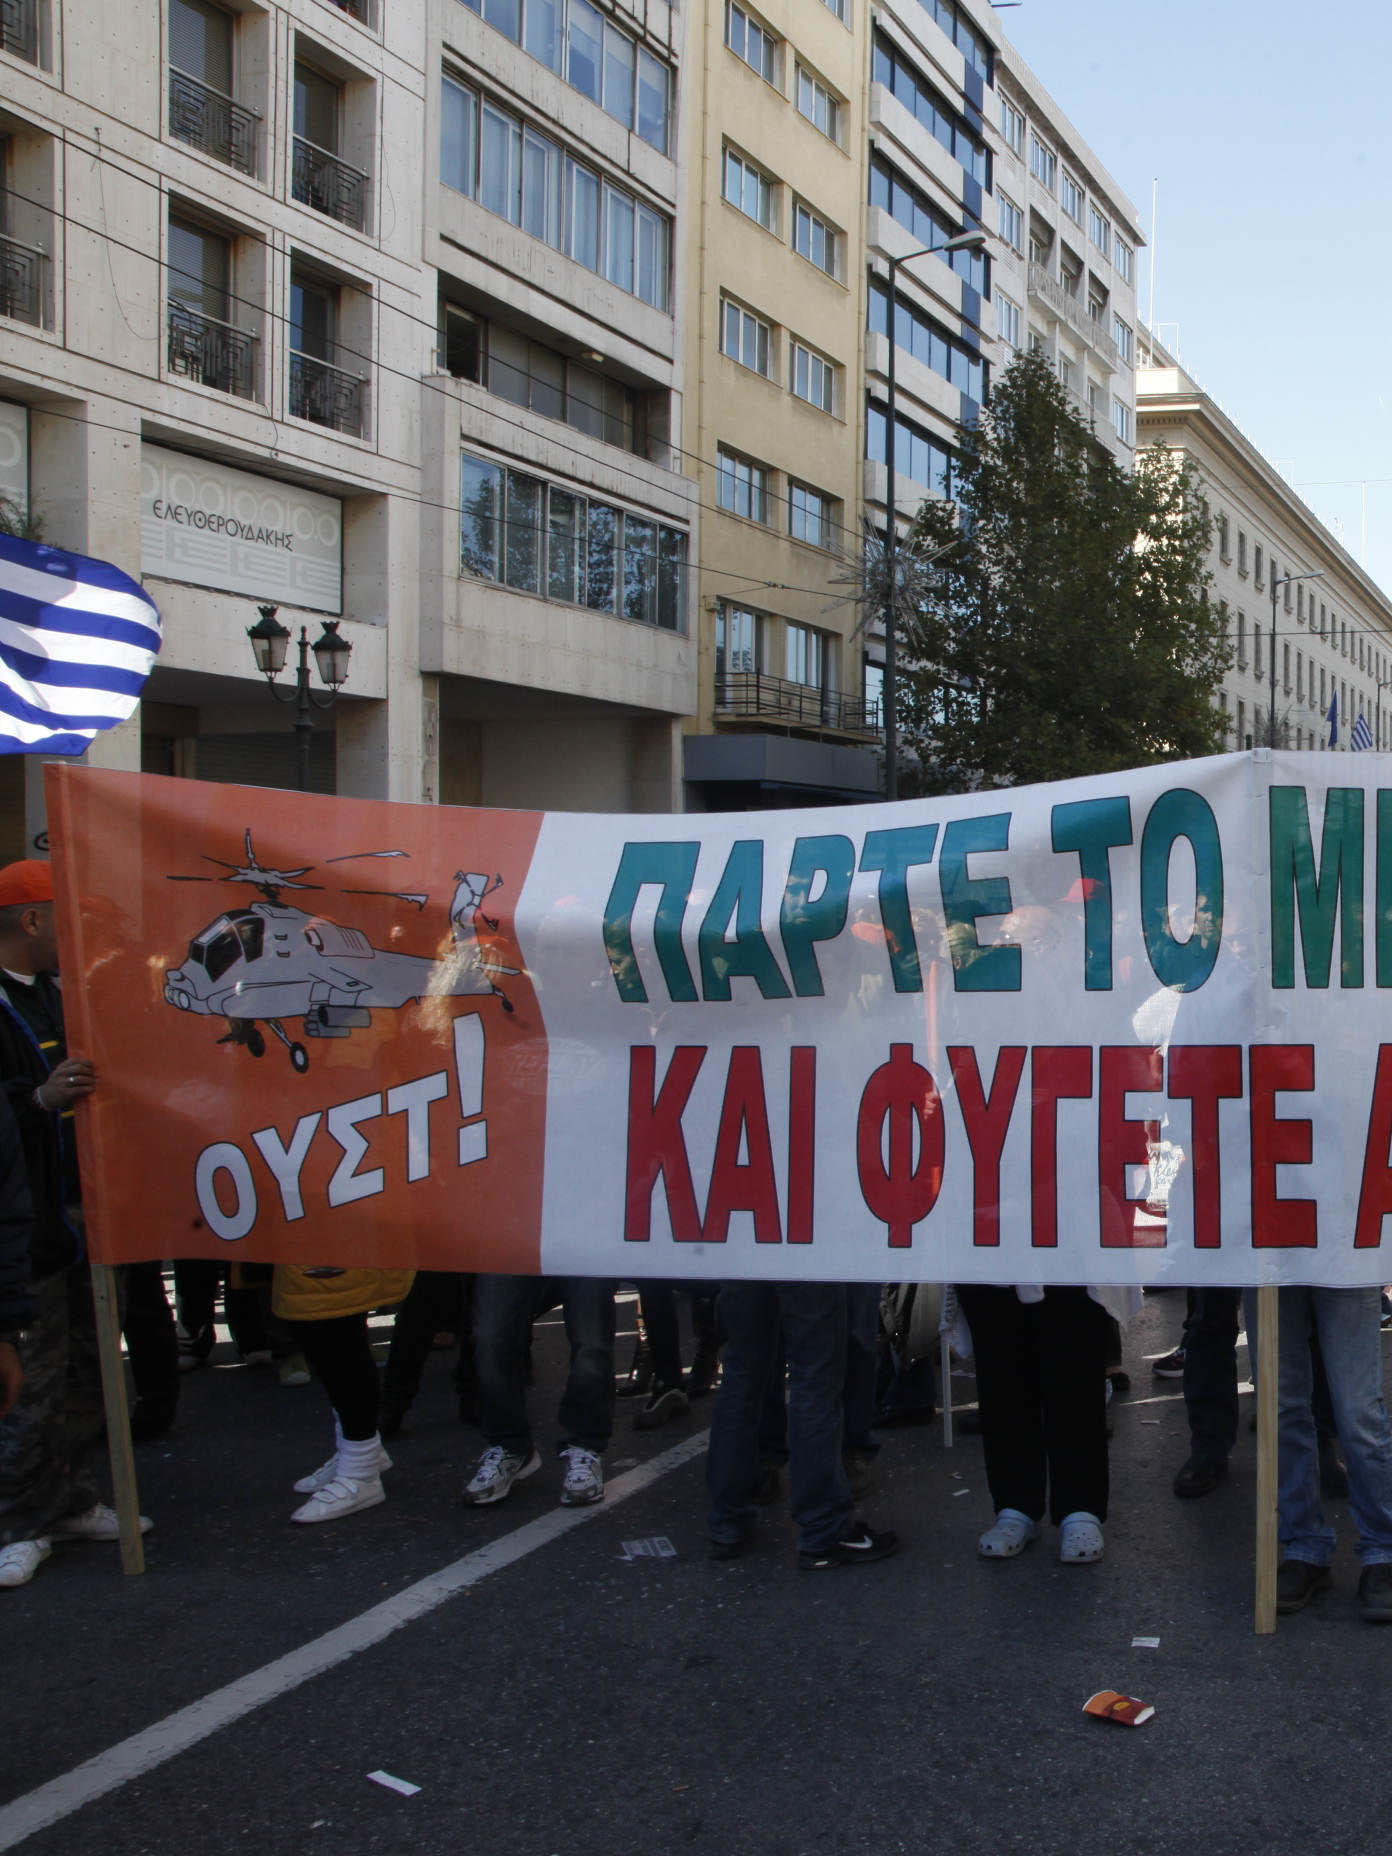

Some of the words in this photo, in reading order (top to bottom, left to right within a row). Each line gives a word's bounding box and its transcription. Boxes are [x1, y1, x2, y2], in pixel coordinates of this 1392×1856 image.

[153, 499, 294, 552] ΕΛΕΥΘΕΡΟΥΔΑΚΗΣ
[603, 812, 1022, 1002] ΠΑΡΤΕ
[1051, 788, 1223, 992] ΤΟ
[195, 1012, 488, 1241] ΟΥΣΤ!
[624, 1045, 816, 1244] ΚΑΙ
[857, 1043, 1318, 1248] ΦΥΓΕΤΕ
